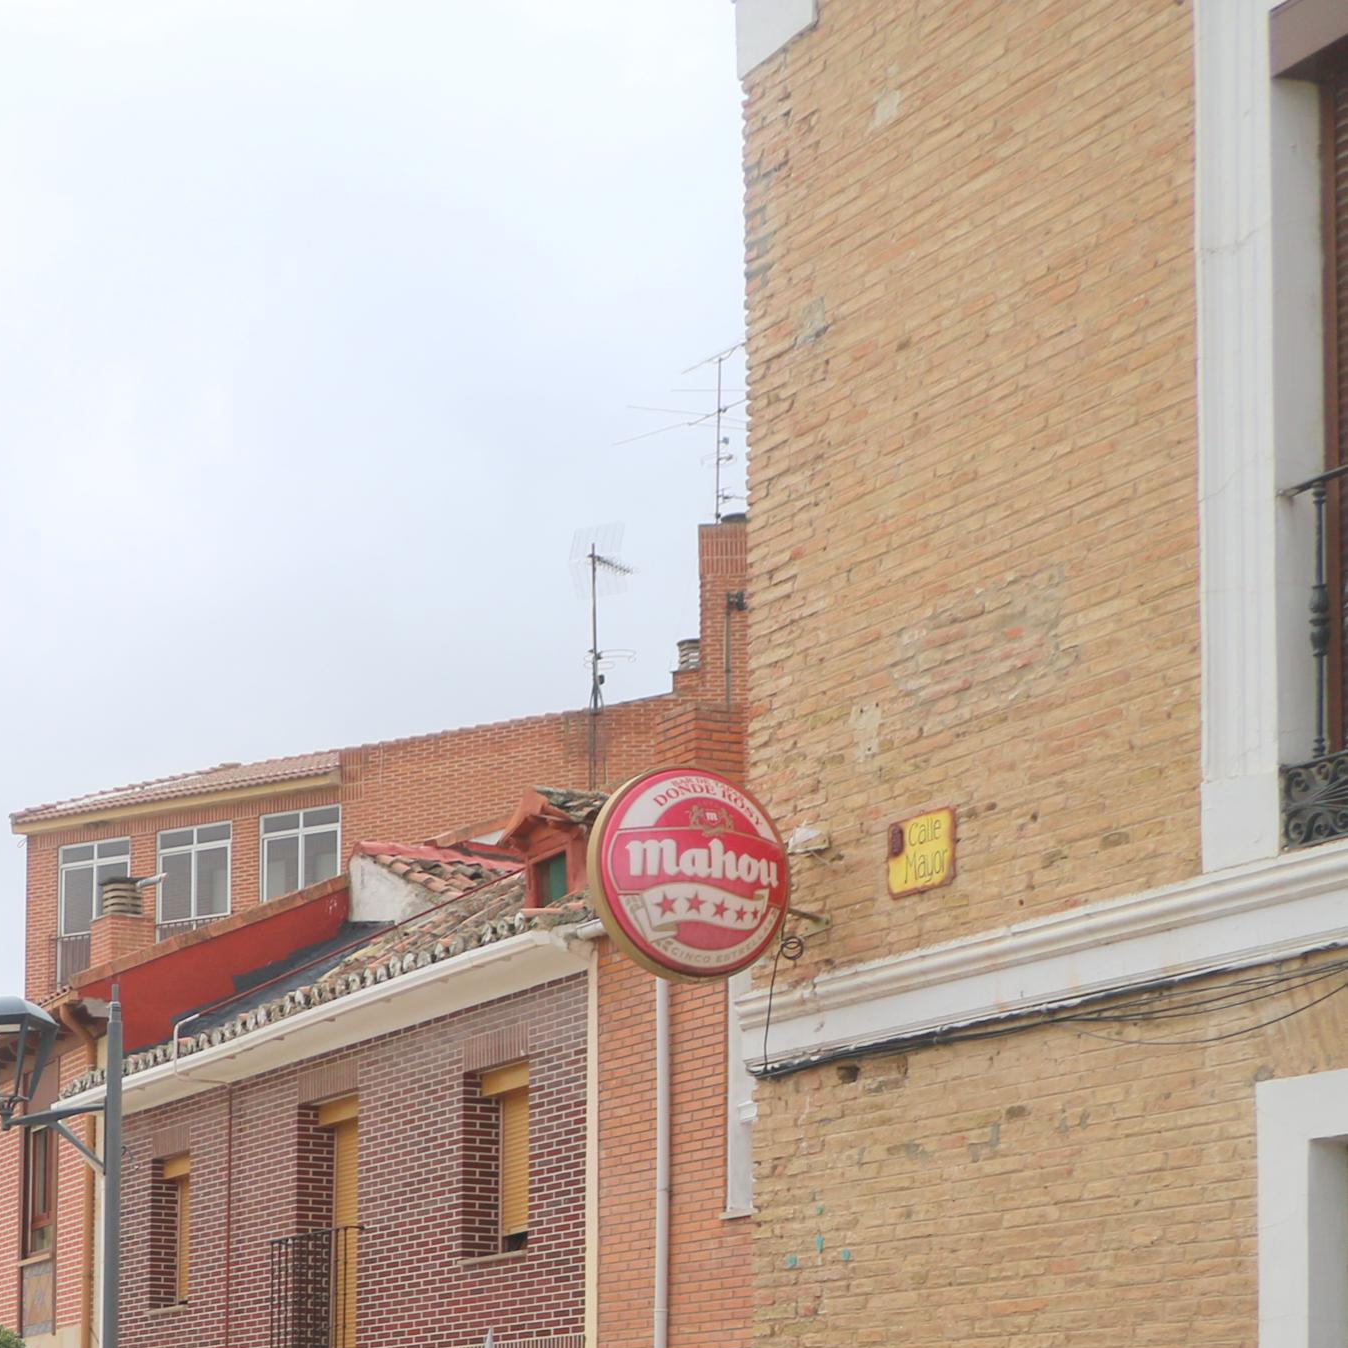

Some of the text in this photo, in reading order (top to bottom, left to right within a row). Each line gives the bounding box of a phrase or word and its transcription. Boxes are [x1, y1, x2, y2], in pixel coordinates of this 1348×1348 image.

[653, 783, 717, 807] DONDE
[721, 785, 763, 826] ROSY
[909, 817, 942, 847] Calle
[904, 848, 948, 884] Mayor
[671, 946, 711, 963] CINCO
